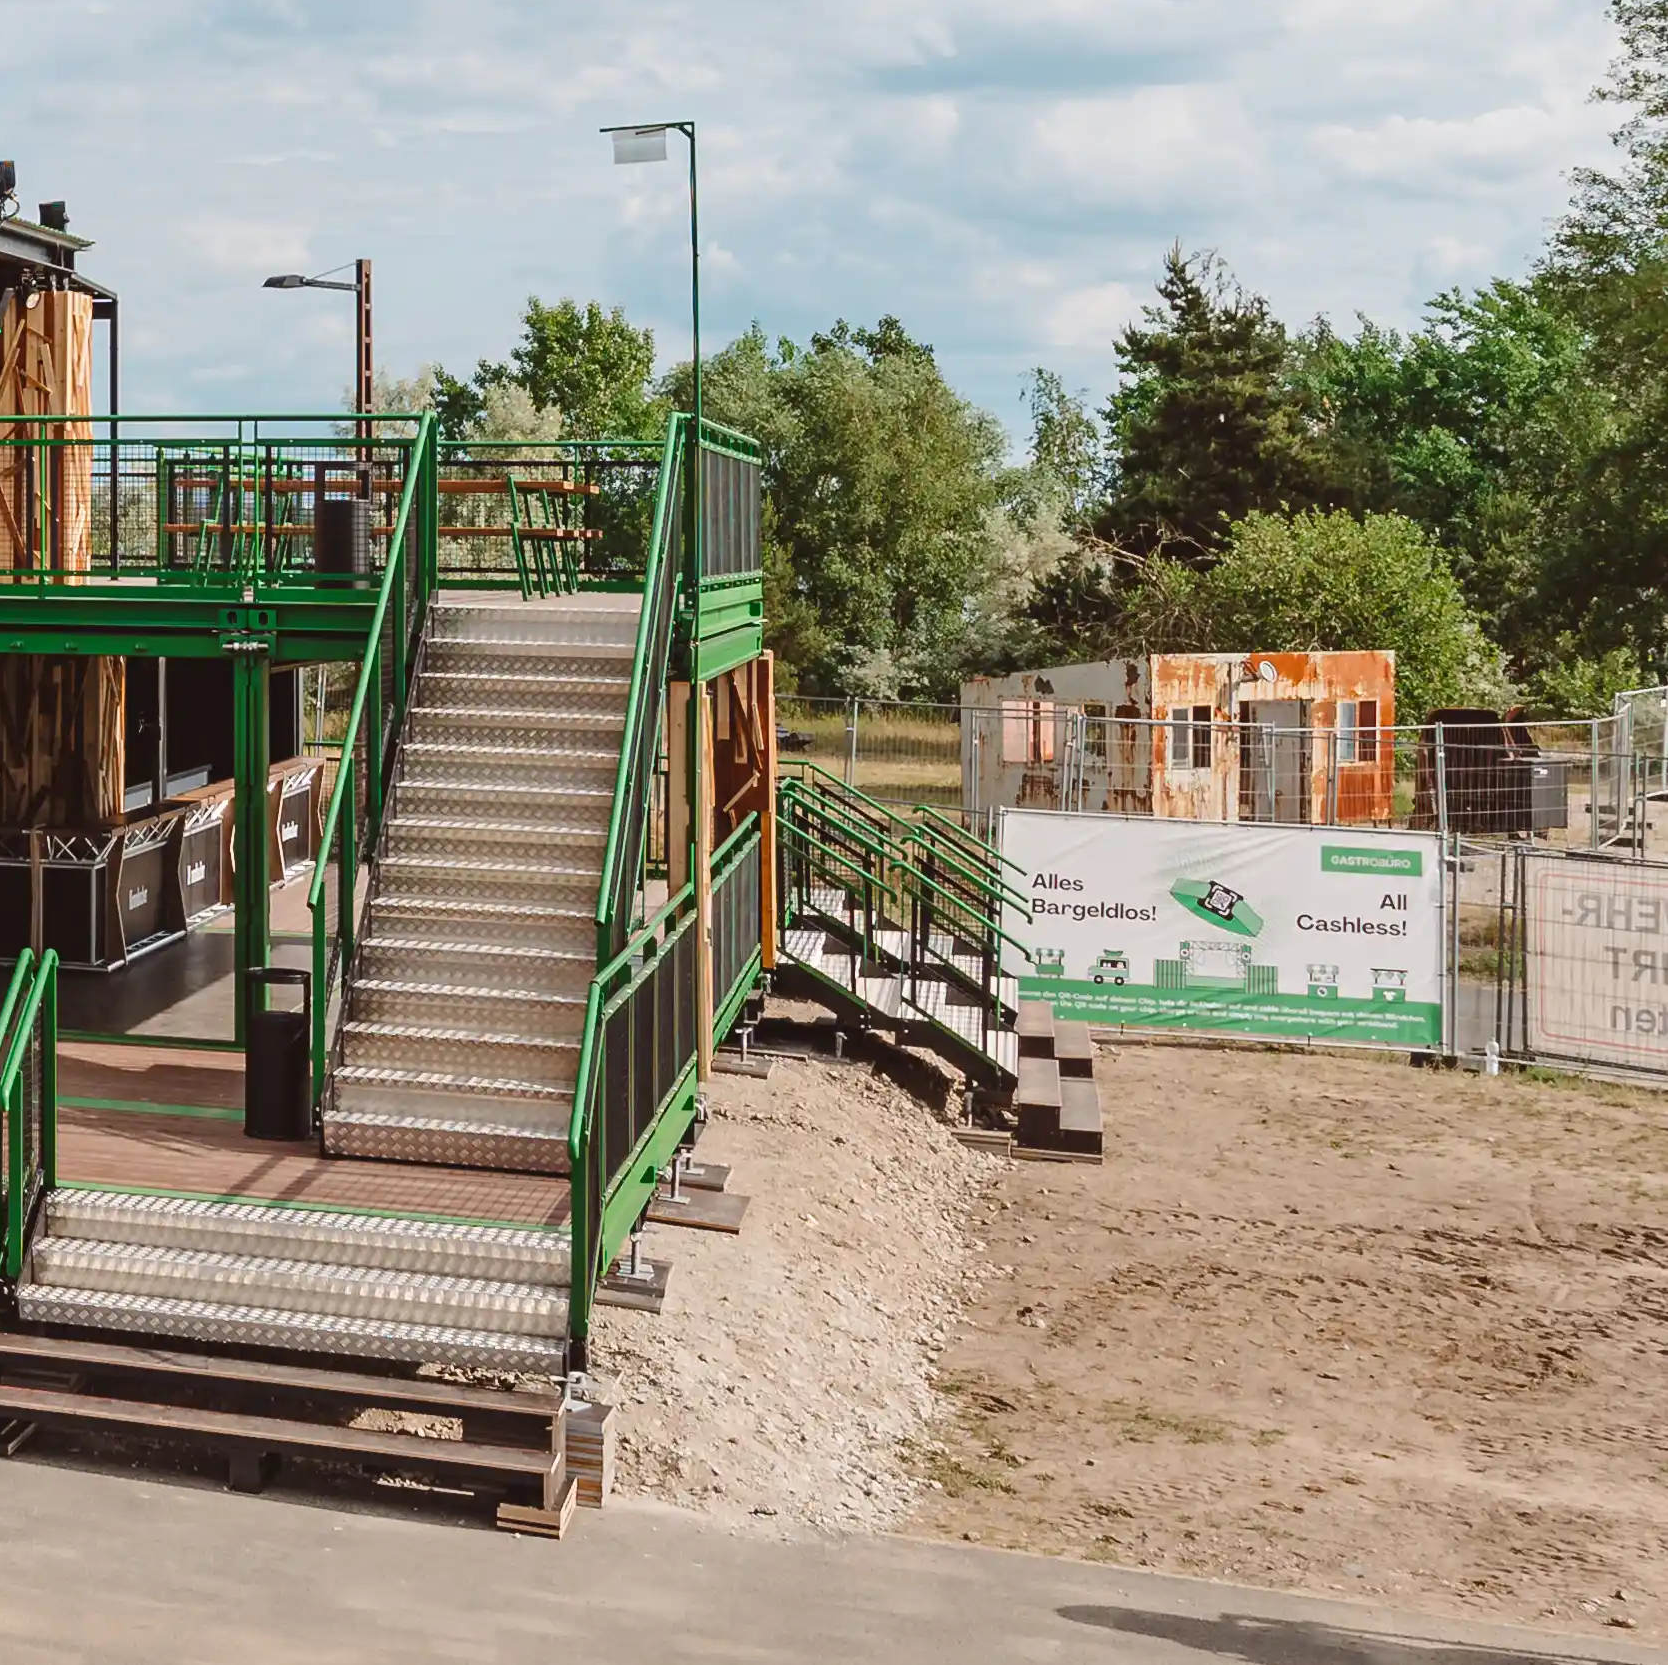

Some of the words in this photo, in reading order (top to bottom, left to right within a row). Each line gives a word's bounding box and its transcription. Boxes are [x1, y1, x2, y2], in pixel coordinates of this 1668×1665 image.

[1031, 873, 1084, 892] Alles
[1031, 898, 1157, 921] Bargeldlos!
[1380, 894, 1407, 910] All
[1296, 914, 1407, 936] Cashless!
